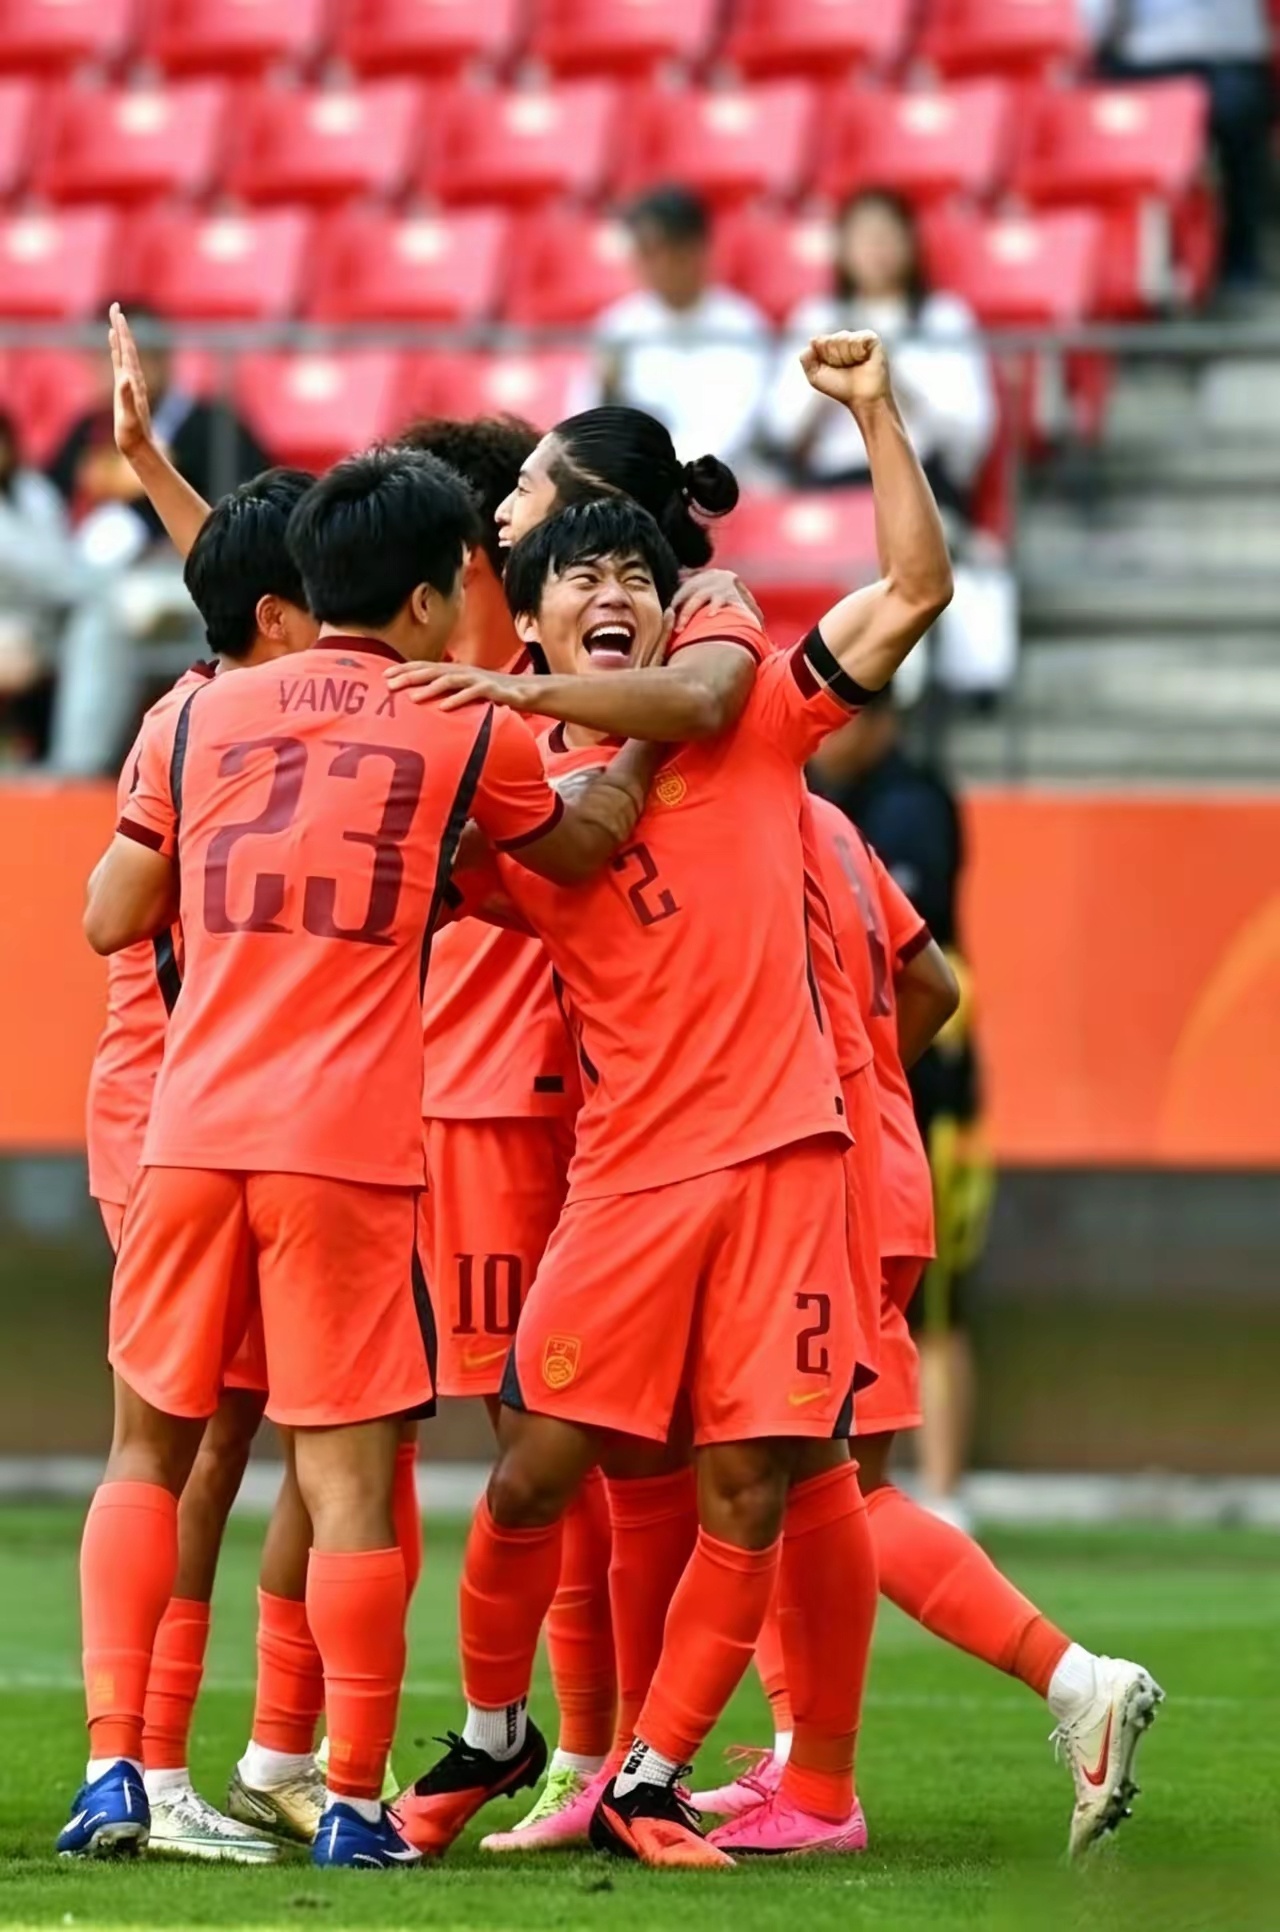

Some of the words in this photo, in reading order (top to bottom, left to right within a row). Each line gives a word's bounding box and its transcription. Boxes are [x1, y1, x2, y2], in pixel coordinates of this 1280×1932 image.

[203, 736, 426, 946] 23
[611, 842, 681, 926] 2
[452, 1253, 522, 1335] 10
[795, 1292, 831, 1376] 2
